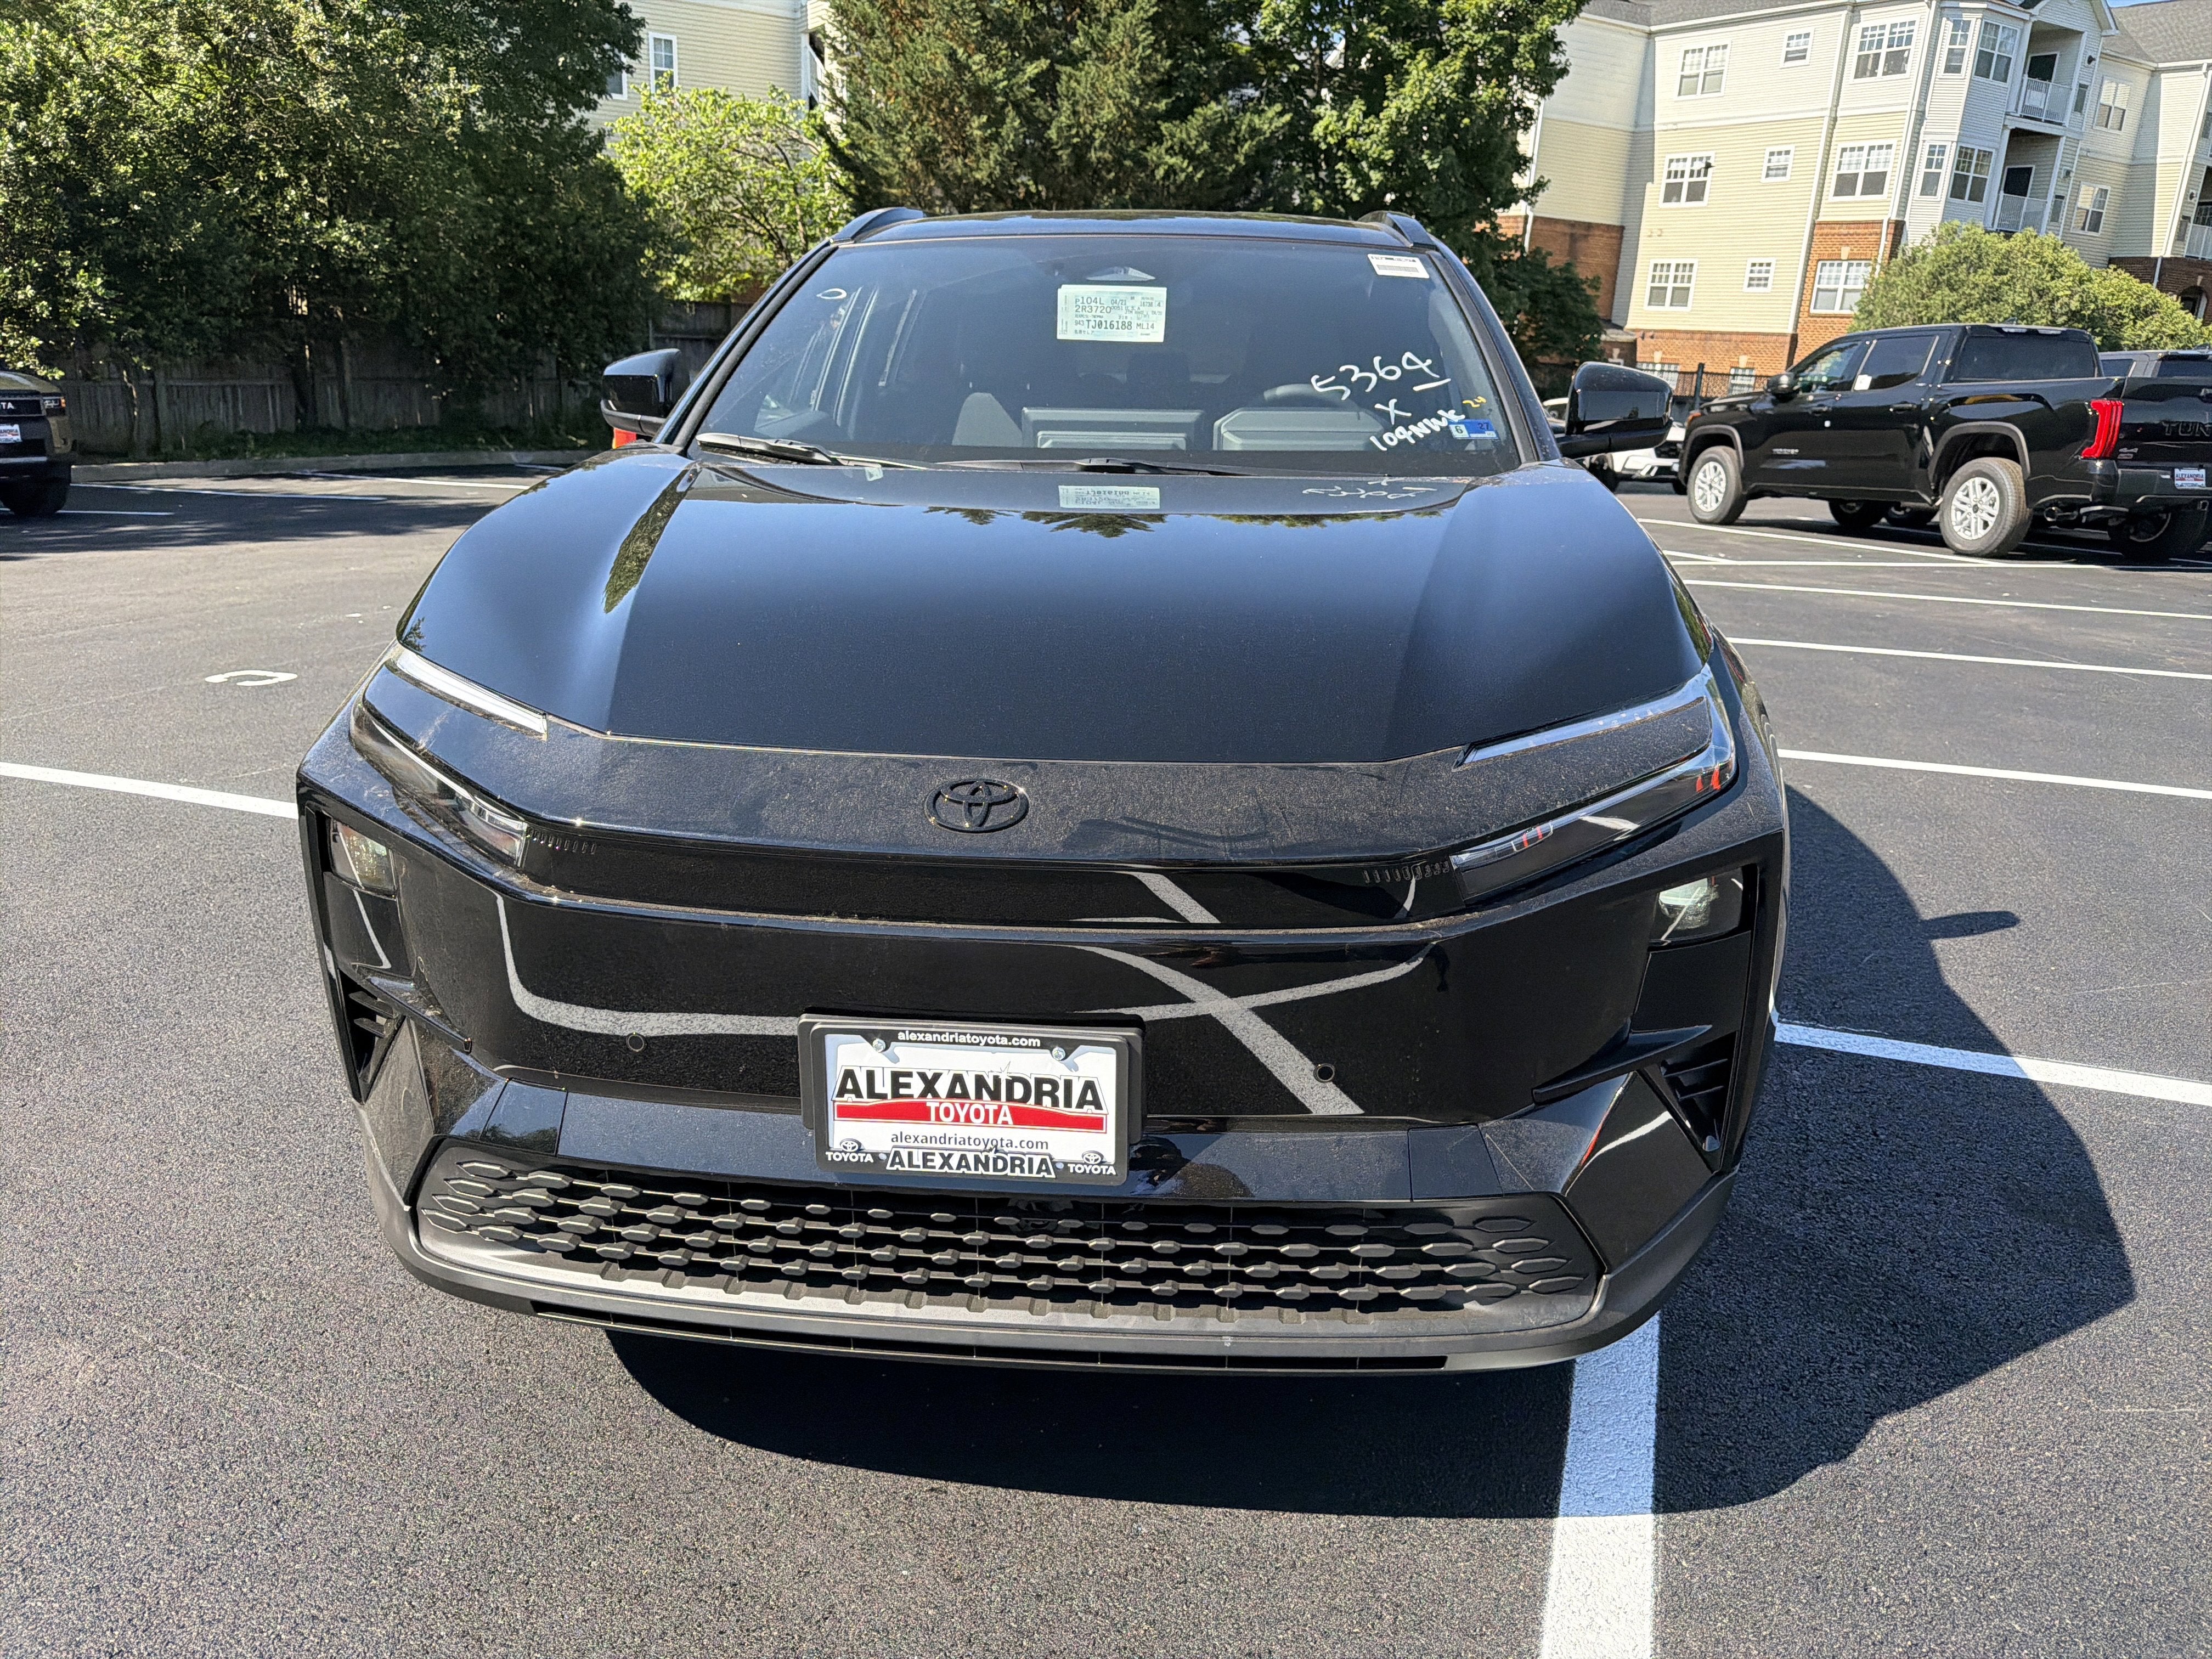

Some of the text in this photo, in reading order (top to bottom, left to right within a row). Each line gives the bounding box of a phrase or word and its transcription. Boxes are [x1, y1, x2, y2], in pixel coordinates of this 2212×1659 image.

[1075, 297, 1104, 305] P104L
[1075, 305, 1111, 313] 2R3720
[1086, 320, 1132, 330] TJ016188
[1311, 352, 1440, 400] 5364
[1374, 399, 1412, 425] X
[1454, 425, 1464, 434] 6
[1478, 422, 1489, 431] 27
[898, 1030, 1041, 1047] alexandriatoyota.com
[835, 1068, 1104, 1111] ALEXANDRIA
[926, 1101, 1014, 1125] TOYOTA
[891, 1131, 1049, 1150] alexandriatoyota.com
[826, 1152, 874, 1163] TOYOTA
[889, 1150, 1052, 1176] ALEXANDRIA
[1067, 1164, 1116, 1175] TOYOTA
